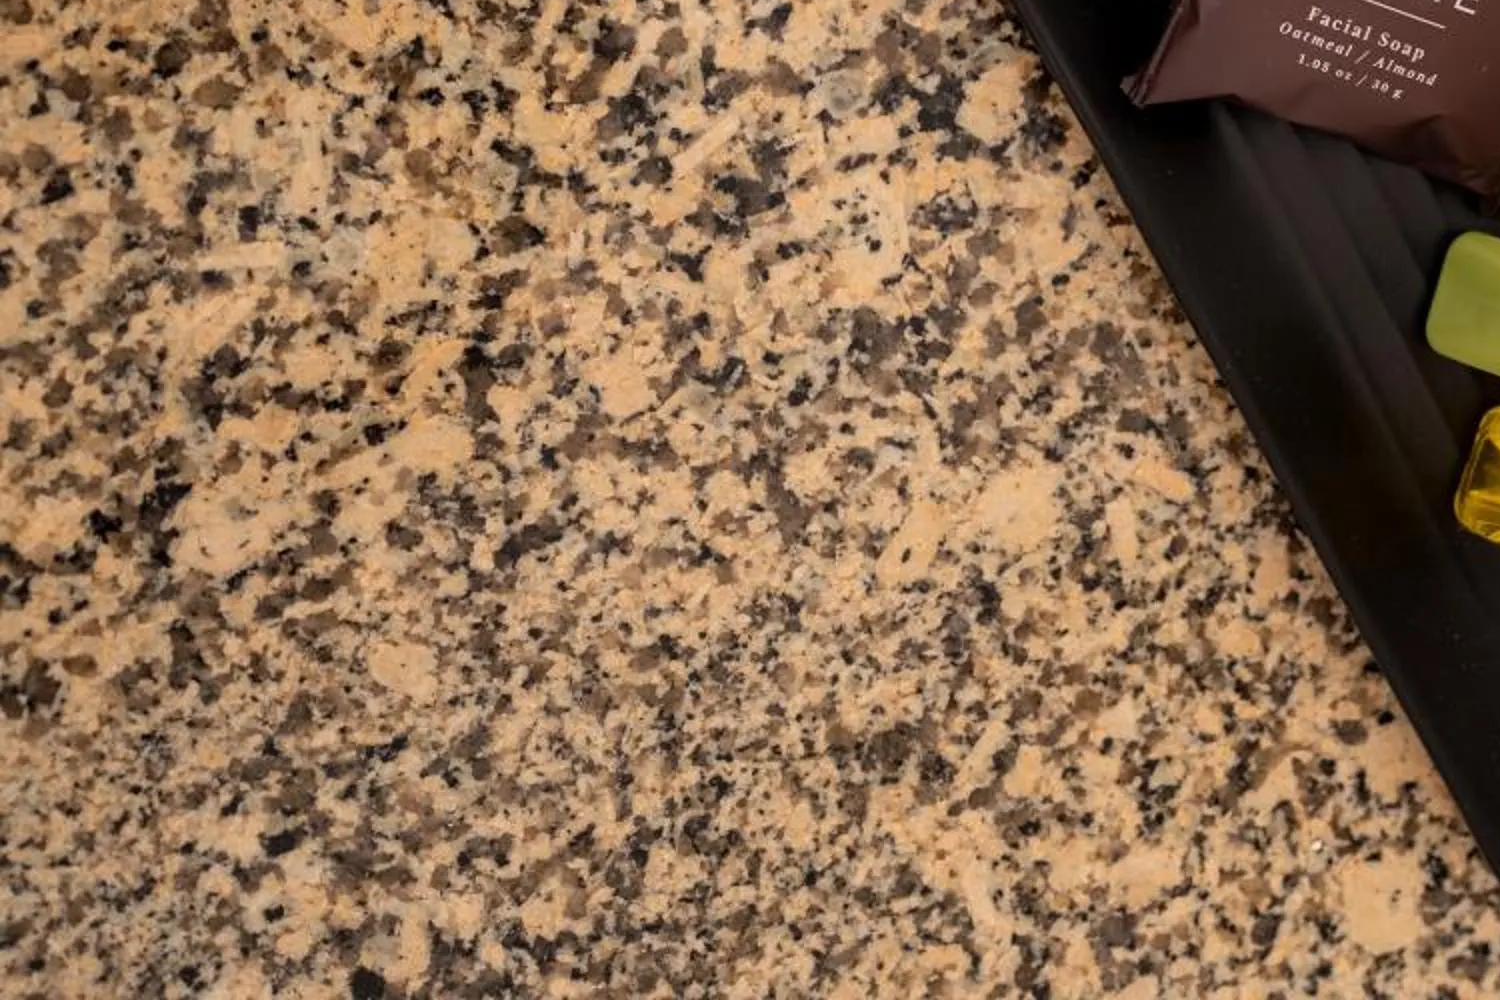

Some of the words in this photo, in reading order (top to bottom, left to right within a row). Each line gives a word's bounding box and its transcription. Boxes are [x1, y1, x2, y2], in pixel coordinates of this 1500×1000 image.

[1279, 21, 1353, 57] Oatmeal
[1355, 51, 1368, 64] /
[1373, 56, 1439, 87] Almond
[1306, 6, 1371, 41] Facial
[1377, 32, 1426, 62] Soap
[1297, 54, 1330, 73] 1.05
[1335, 69, 1353, 81] oz
[1356, 74, 1368, 87] /
[1371, 79, 1390, 93] 30
